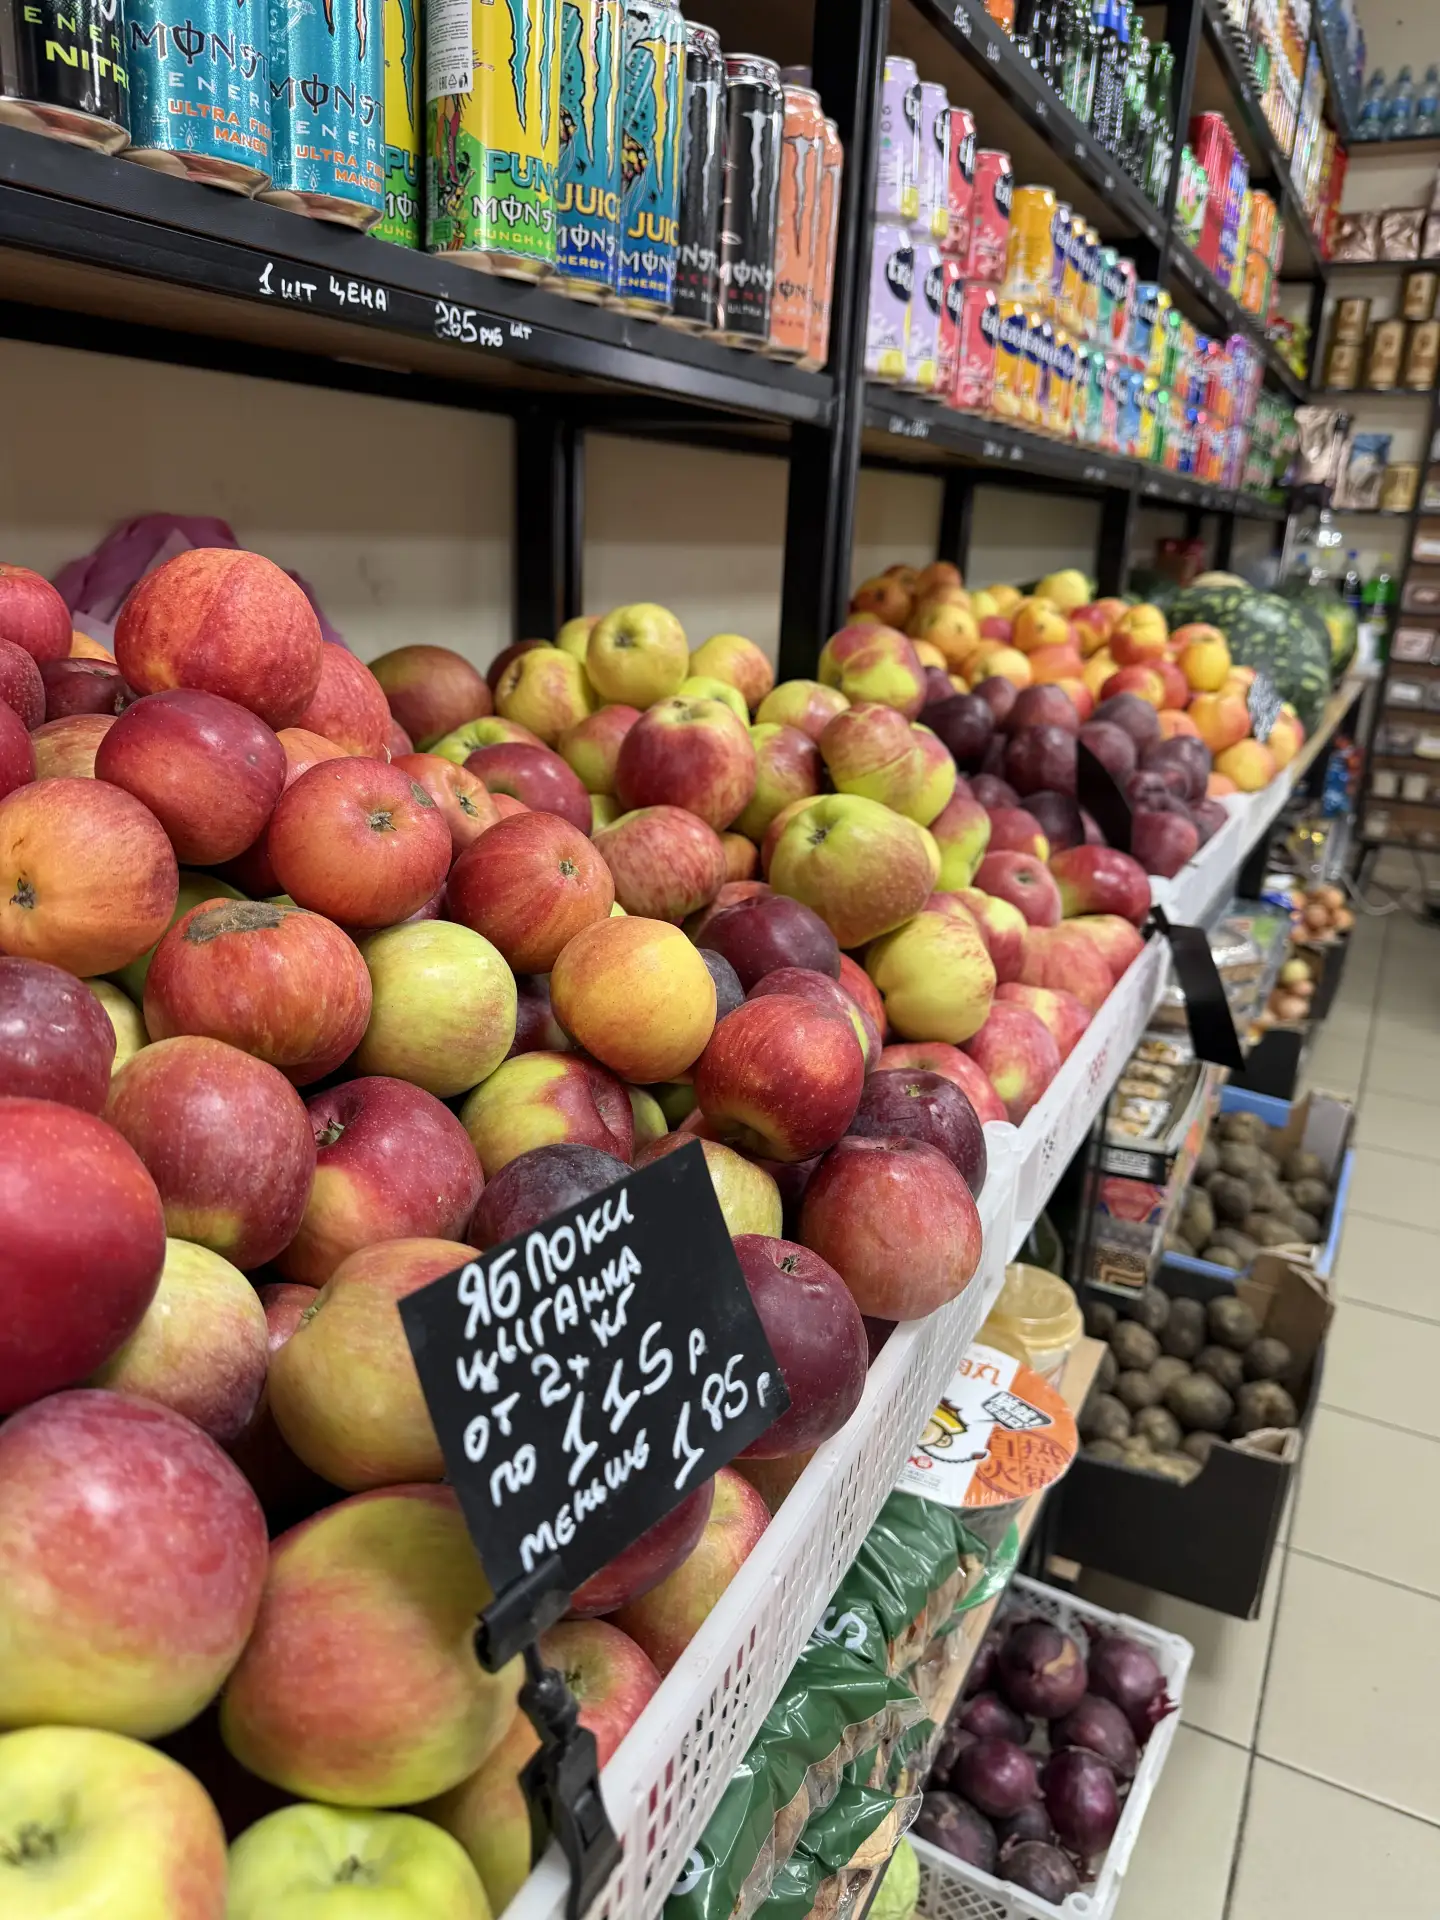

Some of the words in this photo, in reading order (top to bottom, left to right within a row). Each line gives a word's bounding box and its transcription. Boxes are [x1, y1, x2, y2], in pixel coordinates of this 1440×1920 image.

[45, 40, 130, 89] NITR
[168, 98, 241, 126] ULTRA
[295, 145, 359, 169] ULTRA
[258, 262, 276, 295] 1
[329, 275, 387, 312] ЦЕНА
[672, 1354, 749, 1490] 185
